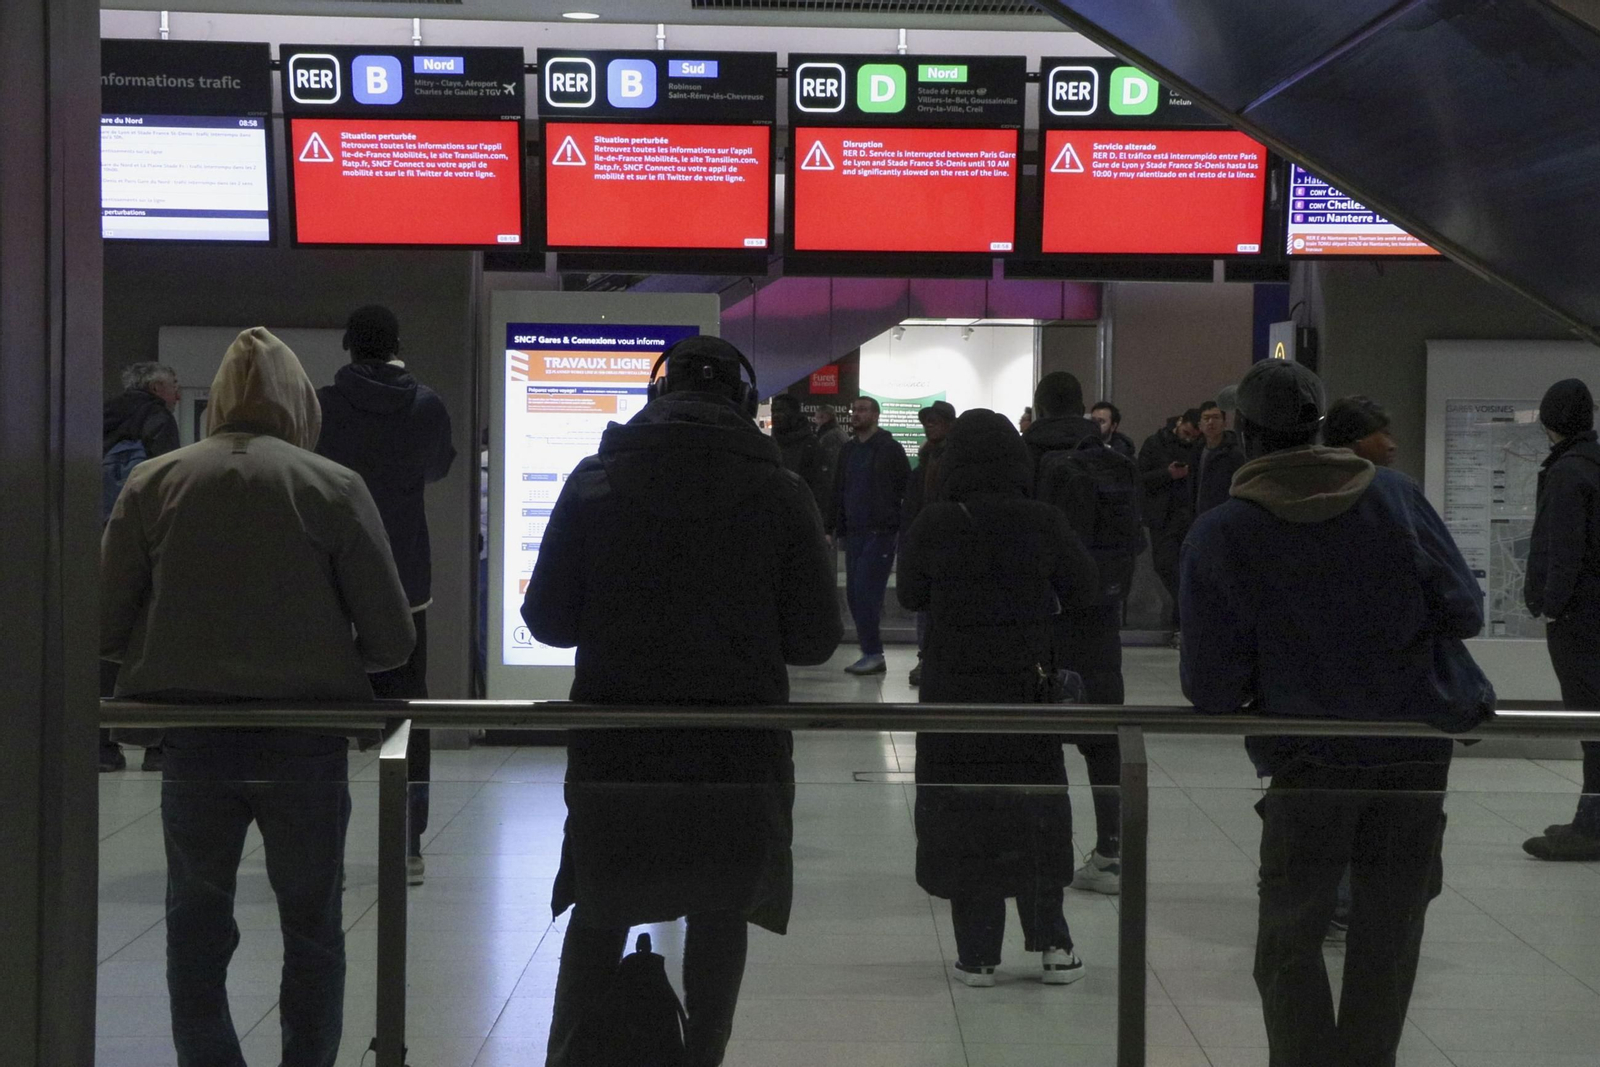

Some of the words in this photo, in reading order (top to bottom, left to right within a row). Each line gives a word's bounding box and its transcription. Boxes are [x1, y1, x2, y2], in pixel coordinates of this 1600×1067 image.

[424, 59, 454, 70] Nord
[681, 63, 705, 74] Sud
[928, 67, 958, 79] Nord
[198, 76, 240, 88] trafic
[297, 69, 333, 89] RER
[366, 66, 388, 94] B
[414, 79, 434, 88] Mitry
[440, 80, 463, 88] Claye,
[464, 80, 498, 89] Aéroport
[552, 73, 588, 92] RER
[621, 70, 643, 97] B
[803, 78, 838, 97] RER
[870, 75, 895, 102] D
[1055, 82, 1091, 100] RER
[1123, 77, 1148, 105] D
[917, 105, 964, 114] Orry-la-Ville,
[341, 132, 376, 140] Situation
[378, 133, 416, 142] perturbée
[594, 136, 629, 144] Situation
[631, 136, 668, 145] perturbée
[406, 142, 416, 150] les
[418, 142, 464, 150] informations
[480, 143, 501, 152] l'appli
[594, 145, 630, 153] Retrouvez
[669, 146, 715, 154] informations
[730, 147, 752, 156] l'appli
[843, 141, 882, 150] Disruption
[392, 151, 428, 160] Mobilités,
[453, 152, 508, 161] Transilien.com,
[644, 155, 679, 164] Mobilités,
[690, 155, 703, 163] site
[705, 156, 758, 165] Transilien.com,
[869, 150, 895, 158] Service
[904, 150, 945, 160] interrupted
[999, 151, 1015, 159] Gare
[1128, 152, 1151, 160] tráfico
[1153, 152, 1168, 160] está
[1170, 152, 1217, 162] interrumpido
[342, 160, 370, 169] Ratp.fr,
[372, 160, 392, 168] SNCF
[393, 160, 424, 168] Connect
[458, 161, 477, 170] appli
[478, 161, 487, 169] de
[594, 163, 621, 173] Ratp.fr,
[644, 164, 675, 172] Connect
[708, 165, 727, 174] appli
[853, 159, 870, 168] Lyon
[887, 159, 908, 167] Stade
[909, 159, 933, 167] France
[935, 159, 966, 167] St-Denis
[1111, 161, 1120, 169] de
[1121, 161, 1138, 170] Lyon
[1147, 161, 1166, 169] Stade
[375, 169, 383, 177] et
[475, 170, 495, 179] ligne.
[594, 172, 624, 180] mobilité
[666, 173, 692, 181] Twitter
[725, 174, 745, 183] ligne.
[857, 168, 901, 177] significantly
[902, 168, 928, 176] slowed
[1092, 170, 1111, 178] 10:00
[1136, 170, 1176, 178] ralentizado
[1327, 214, 1373, 222] Nanterre
[514, 336, 536, 344] SNCF
[538, 336, 561, 344] Gares
[571, 337, 616, 345] Connexions
[636, 337, 664, 345] informe
[544, 357, 606, 368] TRAVAUX
[610, 358, 650, 369] LIGNE
[1475, 405, 1514, 413] VOISINES
